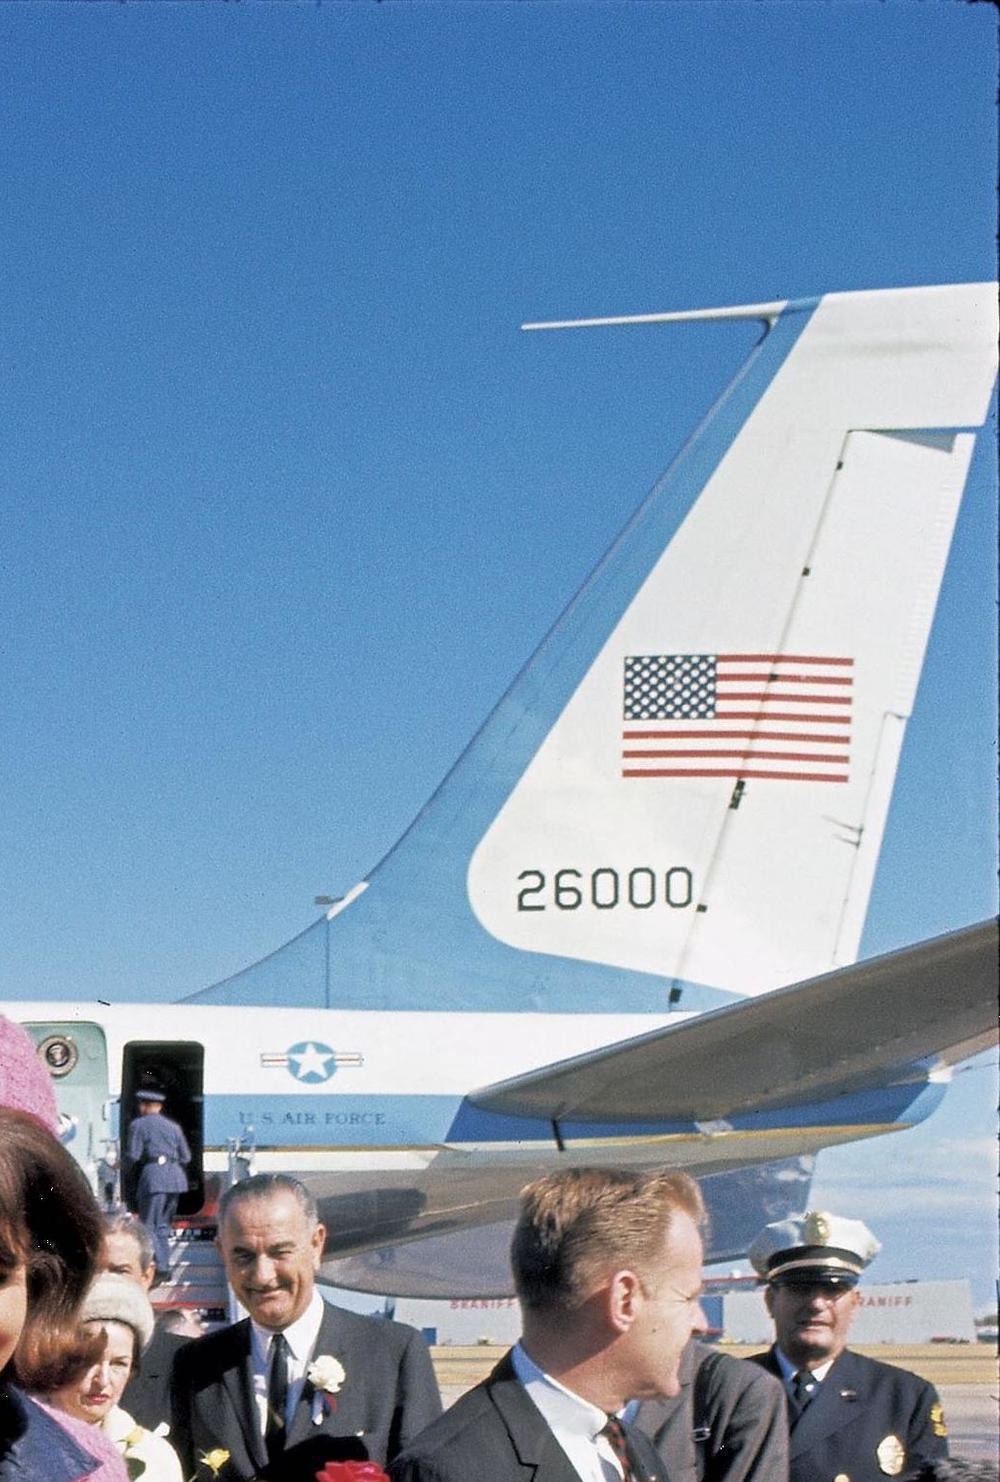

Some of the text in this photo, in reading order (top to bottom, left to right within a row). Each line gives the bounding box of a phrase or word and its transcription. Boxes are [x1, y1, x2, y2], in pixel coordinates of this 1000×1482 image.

[517, 867, 692, 911] 26000
[239, 1111, 386, 1126] U S AIR FORCE
[857, 1295, 913, 1307] RANIFF
